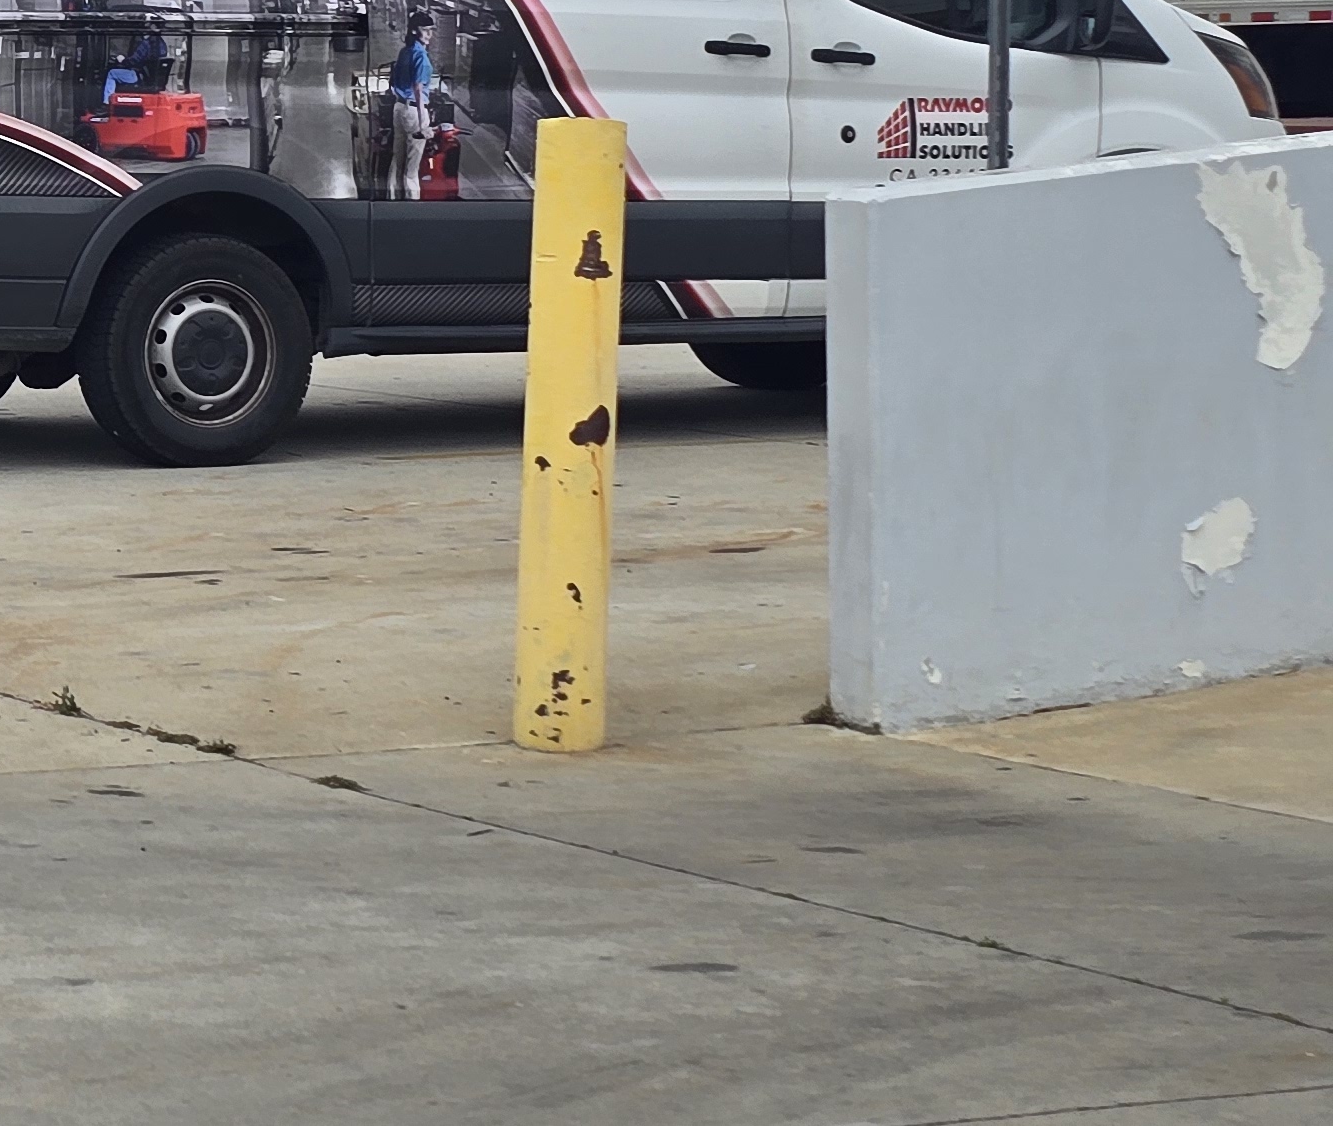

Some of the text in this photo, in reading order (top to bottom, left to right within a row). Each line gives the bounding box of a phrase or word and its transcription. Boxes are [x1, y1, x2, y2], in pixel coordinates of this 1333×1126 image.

[916, 97, 1013, 113] RAYMO
[919, 122, 990, 136] HANDLI
[918, 145, 1014, 160] SOLUTIOS
